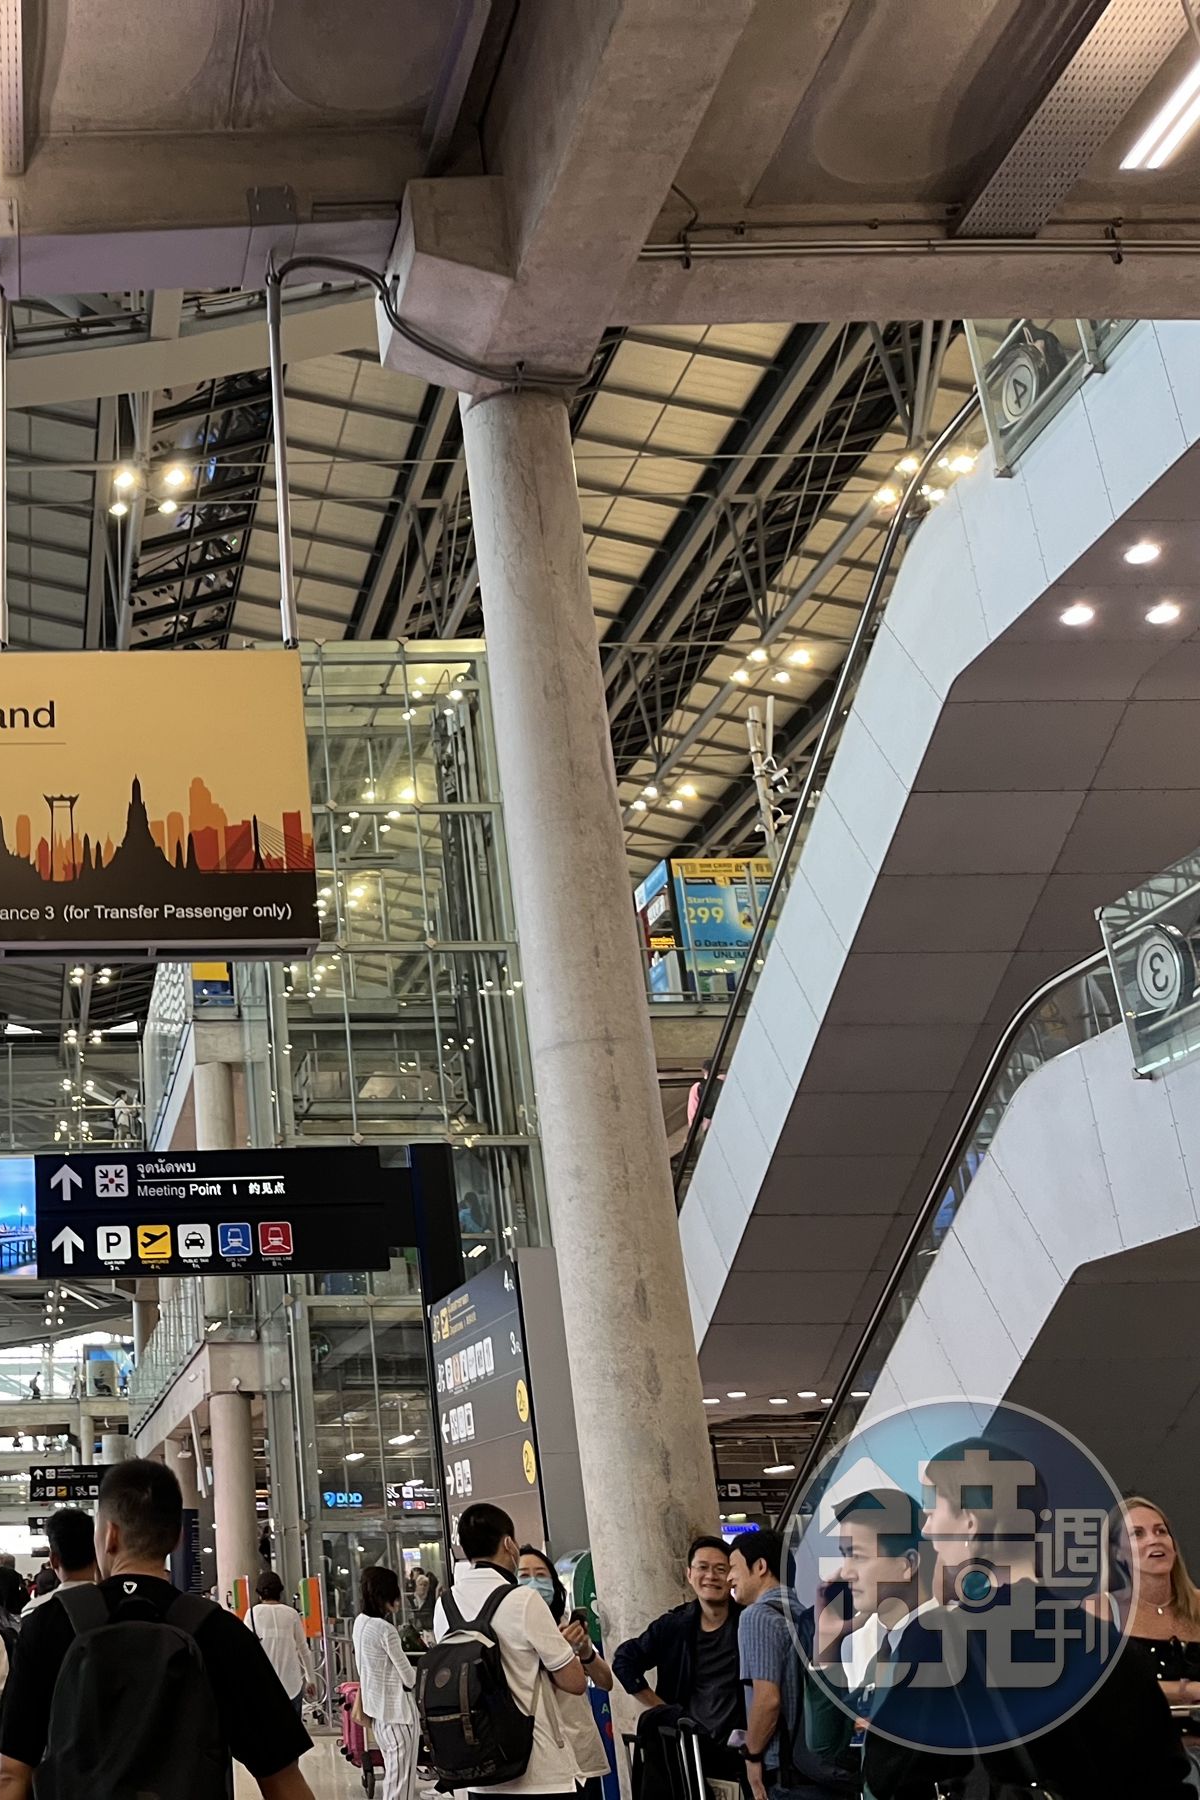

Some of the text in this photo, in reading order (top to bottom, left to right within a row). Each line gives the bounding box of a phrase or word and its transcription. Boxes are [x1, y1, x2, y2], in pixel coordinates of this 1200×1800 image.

[44, 905, 55, 920] 3
[63, 904, 90, 922] (for
[94, 904, 159, 920] Transfer
[164, 903, 248, 921] Passenger
[253, 903, 292, 920] only)
[136, 1158, 196, 1179] จุดนัดพบ
[137, 1183, 222, 1198] Meeting Point
